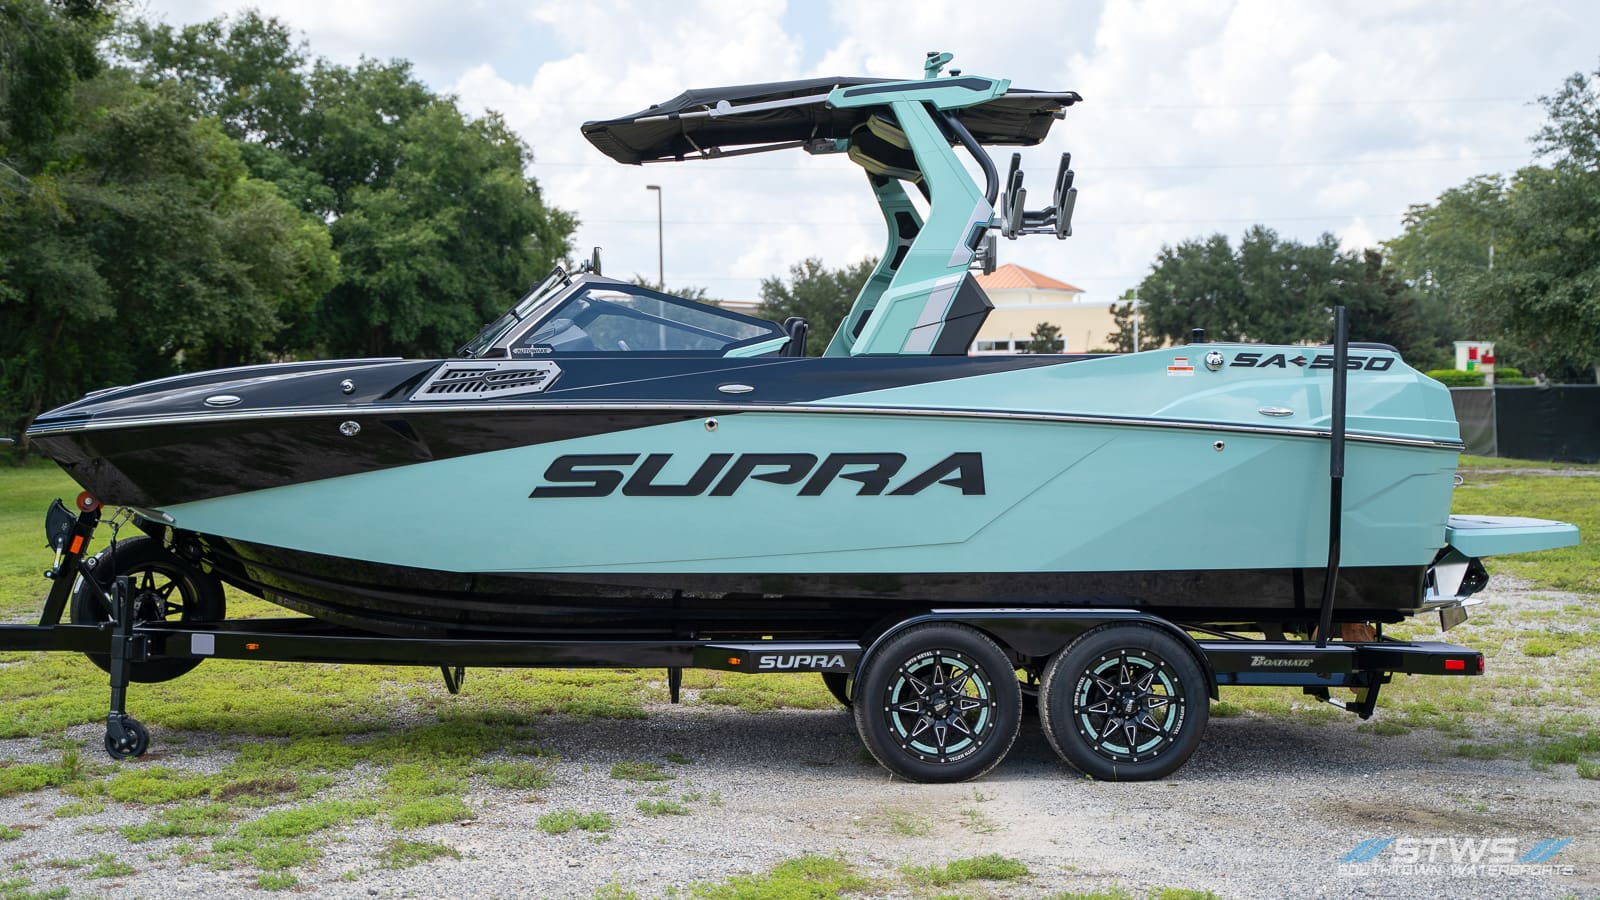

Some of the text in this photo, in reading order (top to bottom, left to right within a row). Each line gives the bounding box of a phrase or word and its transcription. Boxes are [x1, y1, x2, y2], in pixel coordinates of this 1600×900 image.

[1229, 352, 1286, 369] SA
[528, 452, 987, 499] SUPRA
[759, 655, 845, 668] SUPRA
